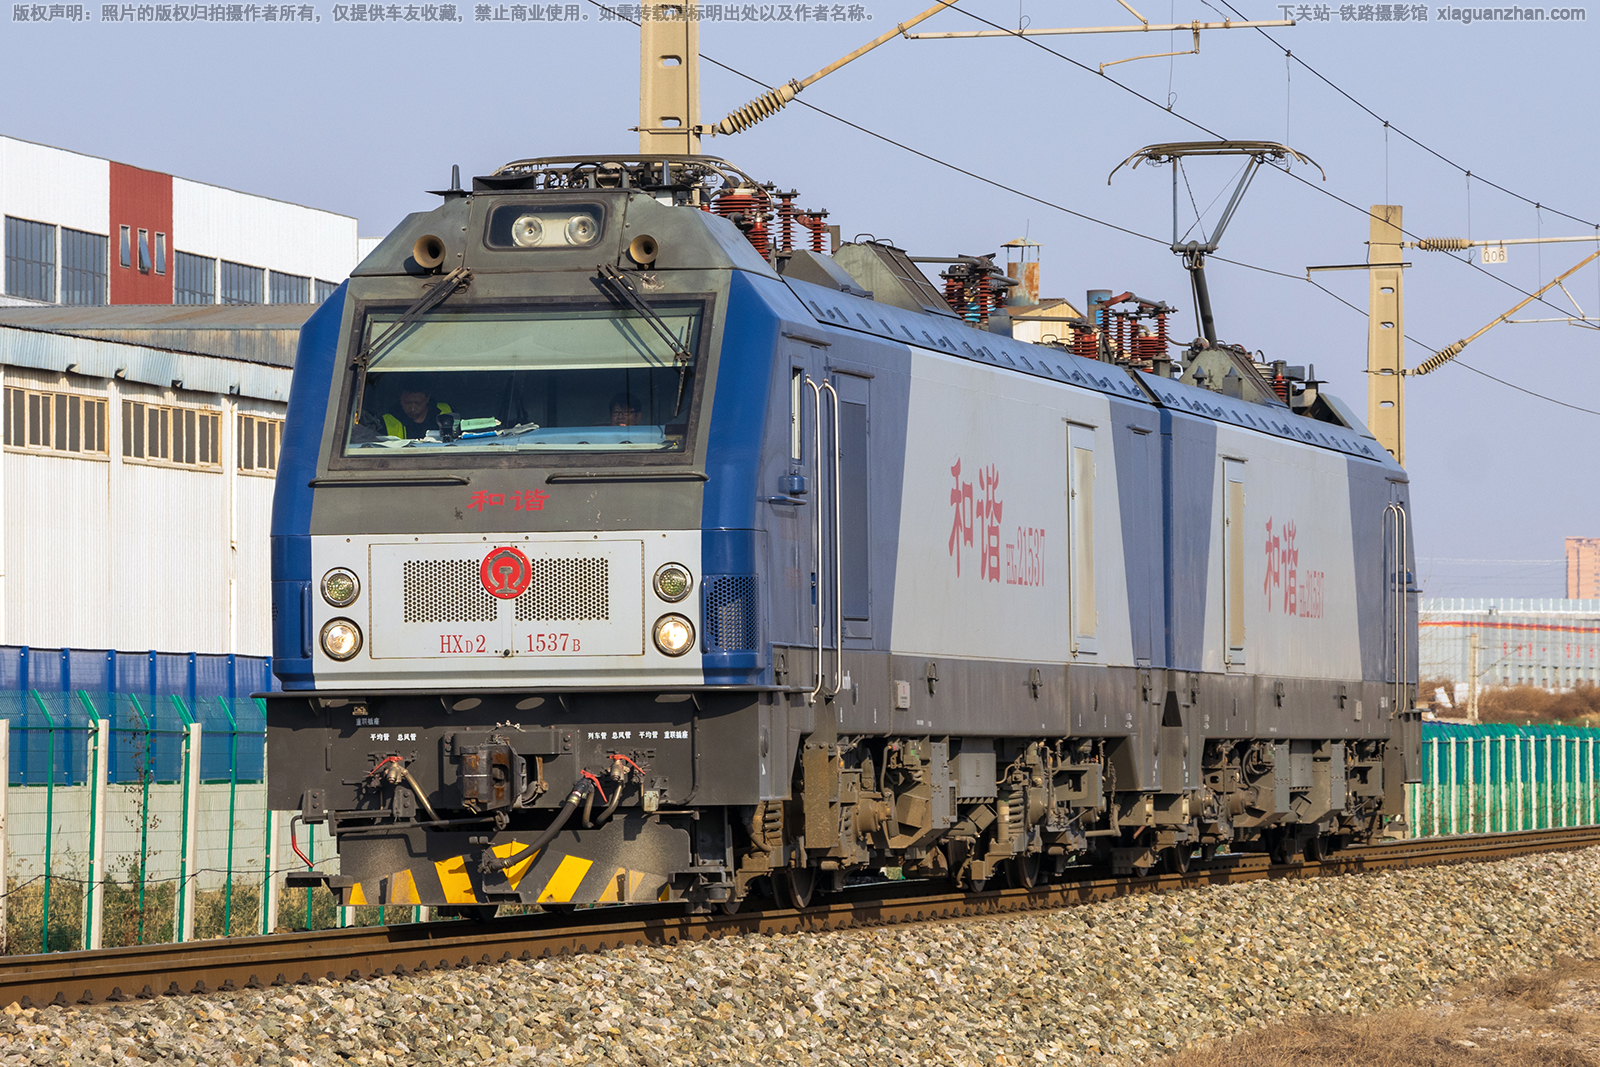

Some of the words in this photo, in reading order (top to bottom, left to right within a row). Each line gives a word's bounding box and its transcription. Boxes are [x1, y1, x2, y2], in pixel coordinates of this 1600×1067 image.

[467, 488, 550, 512] 和谐
[948, 457, 1003, 583] 和谐
[1263, 516, 1299, 616] 和谐
[439, 634, 487, 654] HXD2
[526, 633, 581, 653] 1537B
